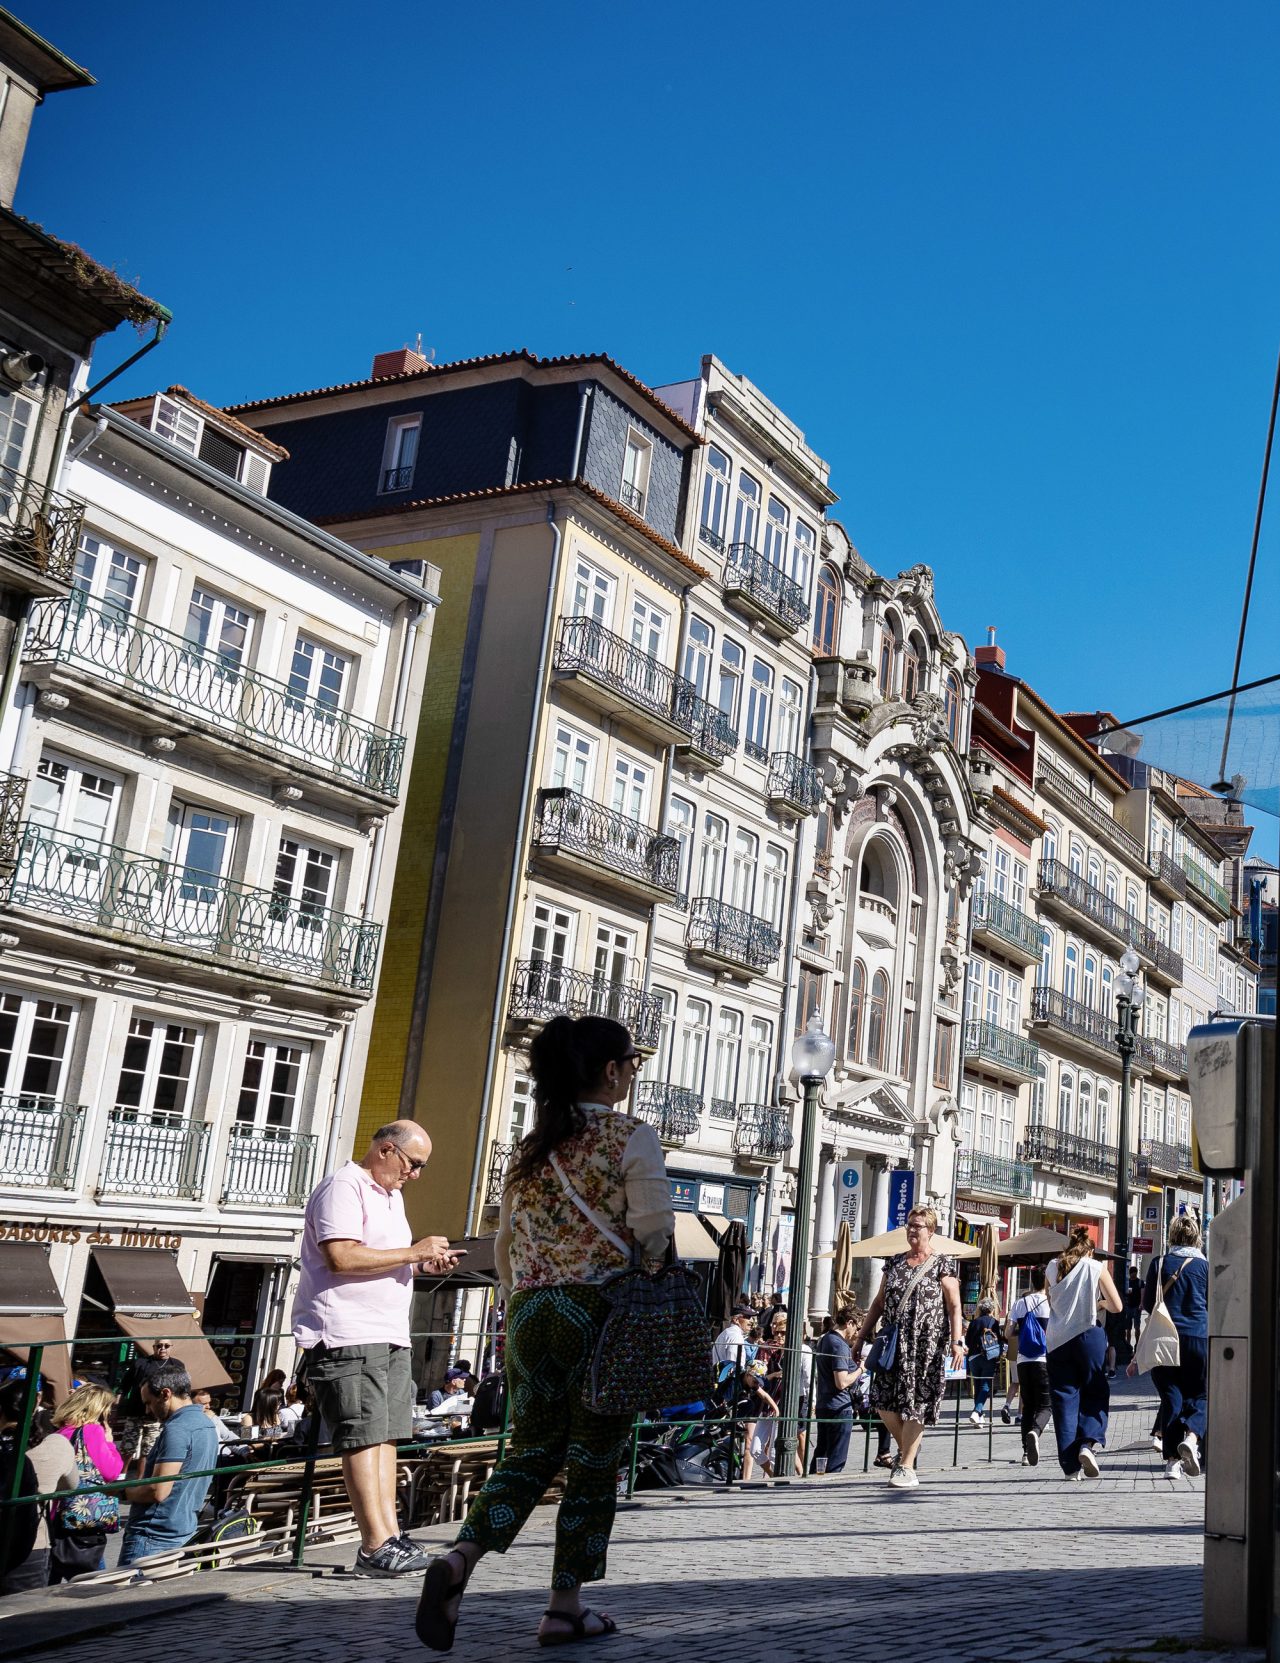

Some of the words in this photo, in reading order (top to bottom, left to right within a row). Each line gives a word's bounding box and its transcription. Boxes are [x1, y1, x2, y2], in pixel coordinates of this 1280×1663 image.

[897, 1179, 908, 1210] Porto.
[849, 1193, 858, 1232] TOURISM
[896, 1212, 906, 1229] isit
[120, 1226, 182, 1249] Invicta
